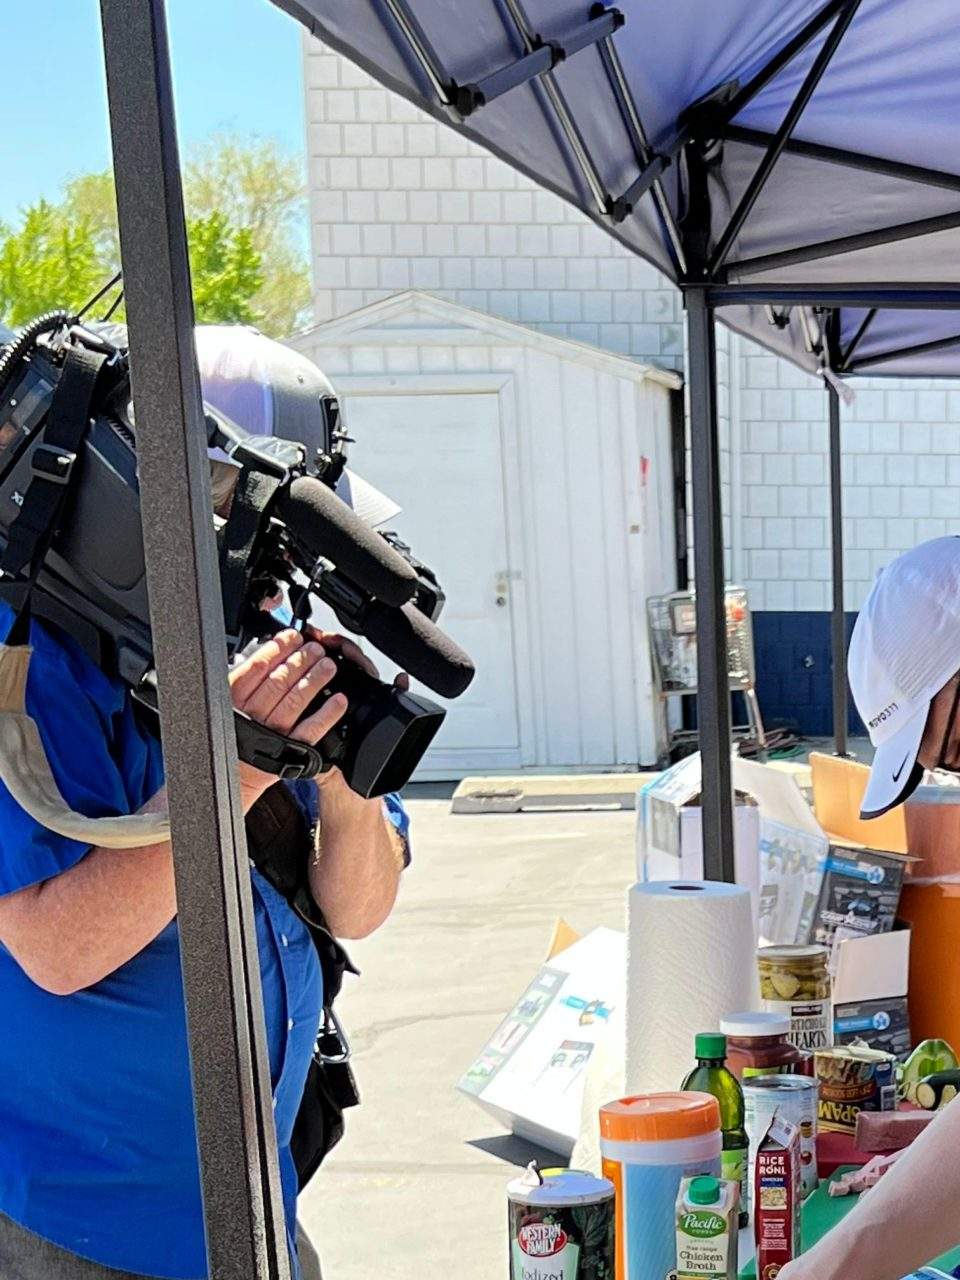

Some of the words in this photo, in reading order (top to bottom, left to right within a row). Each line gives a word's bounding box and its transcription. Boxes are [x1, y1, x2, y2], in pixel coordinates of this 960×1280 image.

[758, 1156, 785, 1166] RICE
[683, 1214, 723, 1230] Pacific
[520, 1223, 562, 1242] WESTERN
[526, 1238, 556, 1255] FAMILY
[680, 1251, 724, 1261] Chicken
[686, 1261, 717, 1271] Broth
